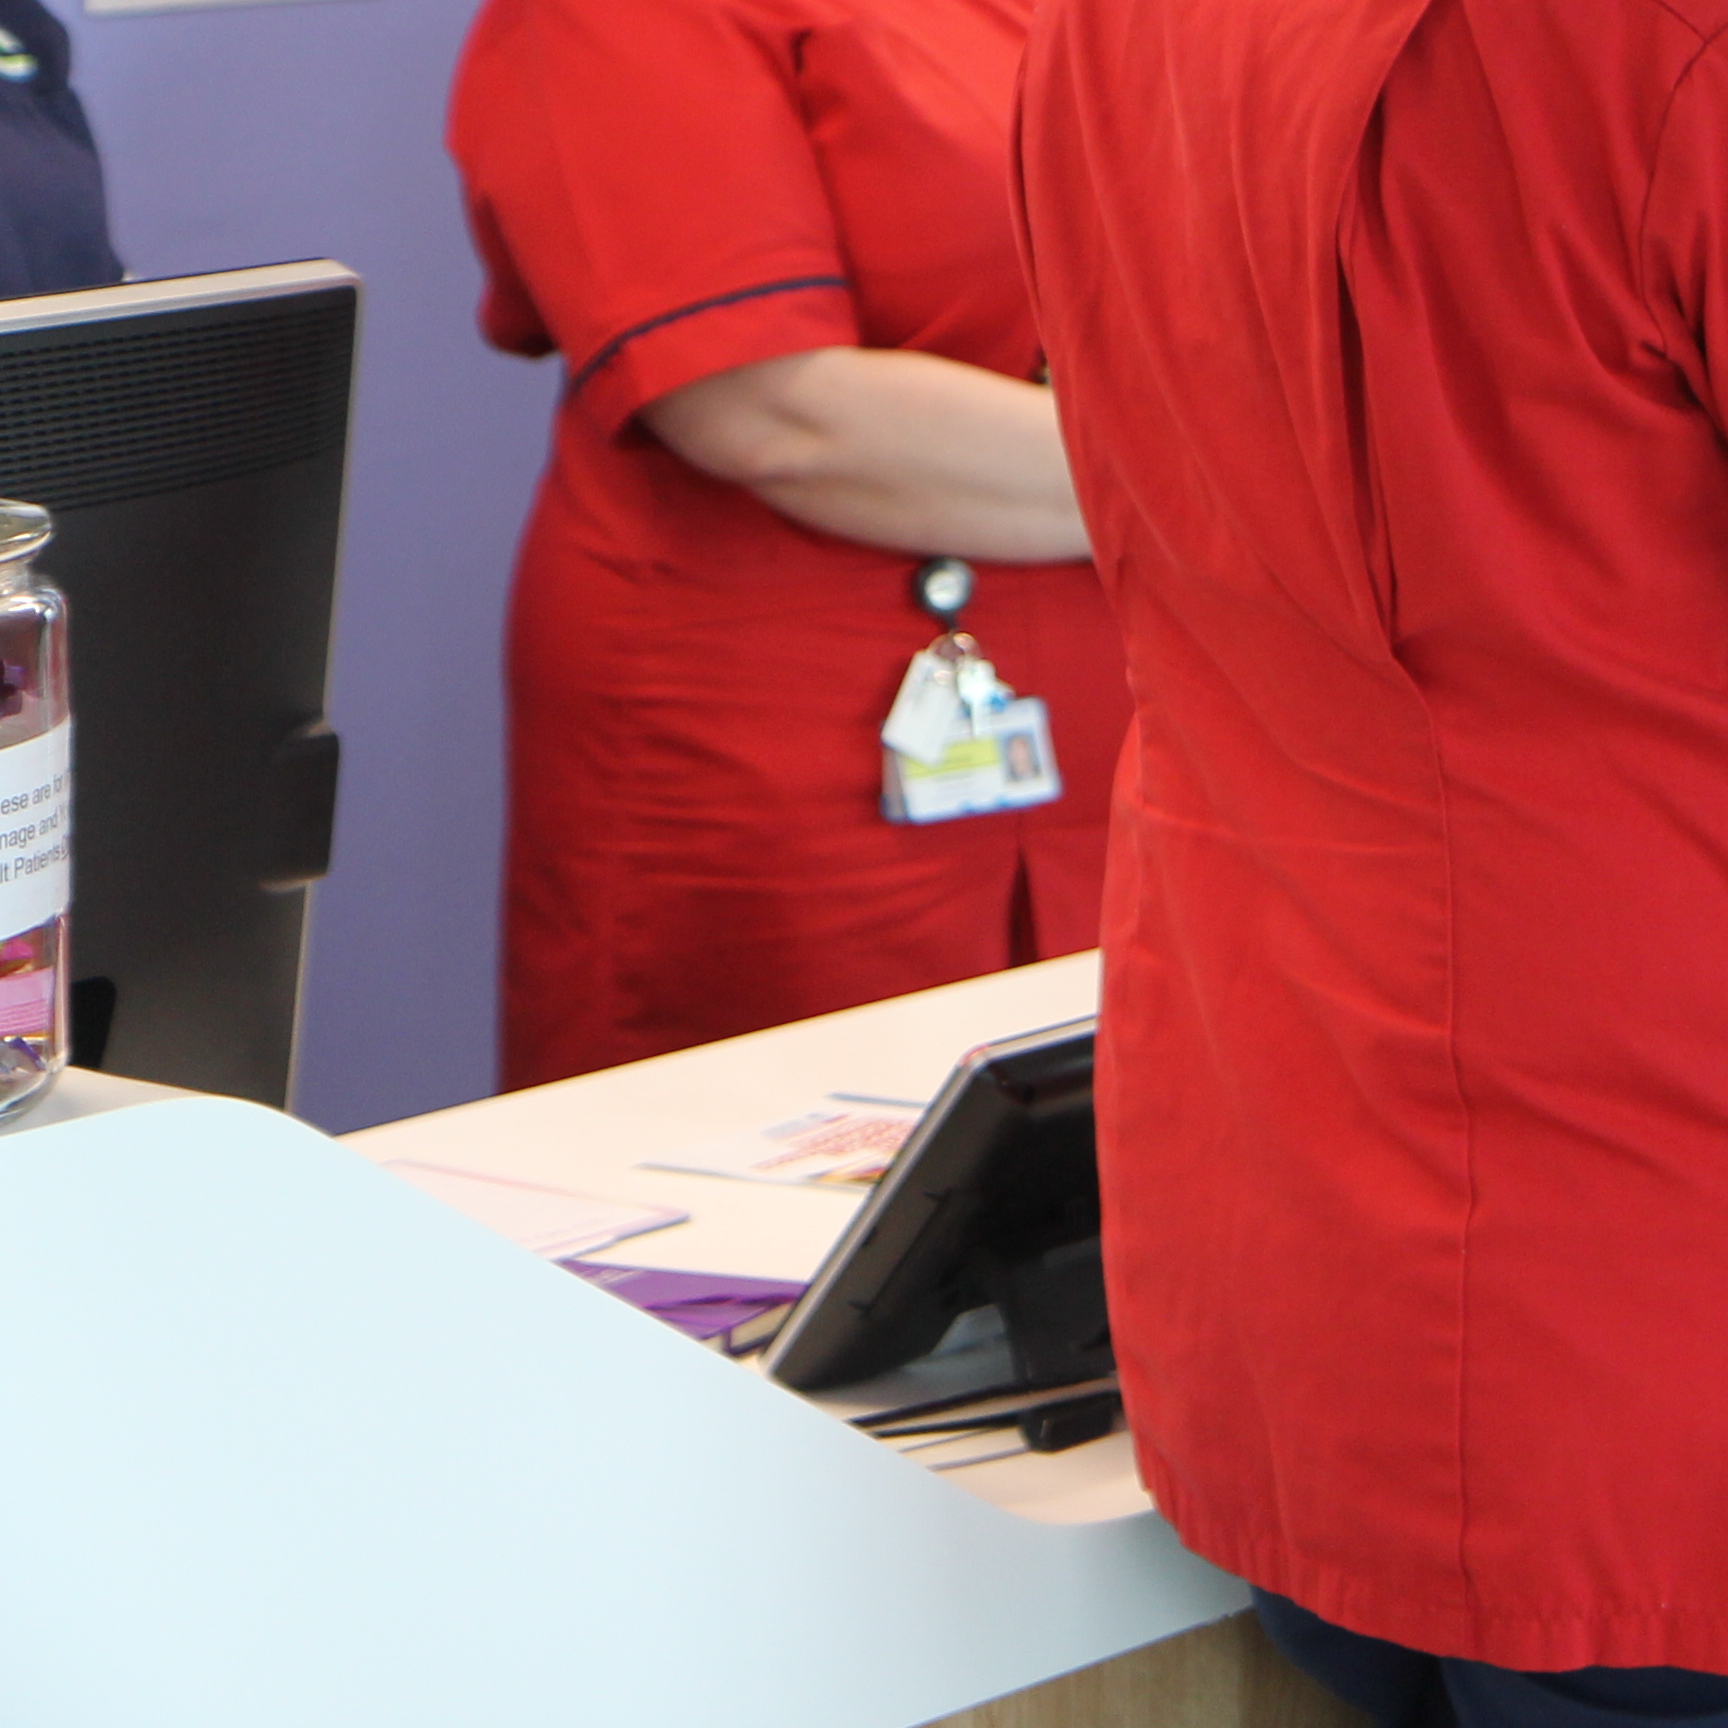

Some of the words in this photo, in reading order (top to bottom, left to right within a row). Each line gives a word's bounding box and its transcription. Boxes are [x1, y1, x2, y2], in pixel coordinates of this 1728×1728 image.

[0, 792, 30, 815] ese
[32, 783, 51, 805] are
[0, 823, 36, 850] nage
[39, 806, 58, 835] and
